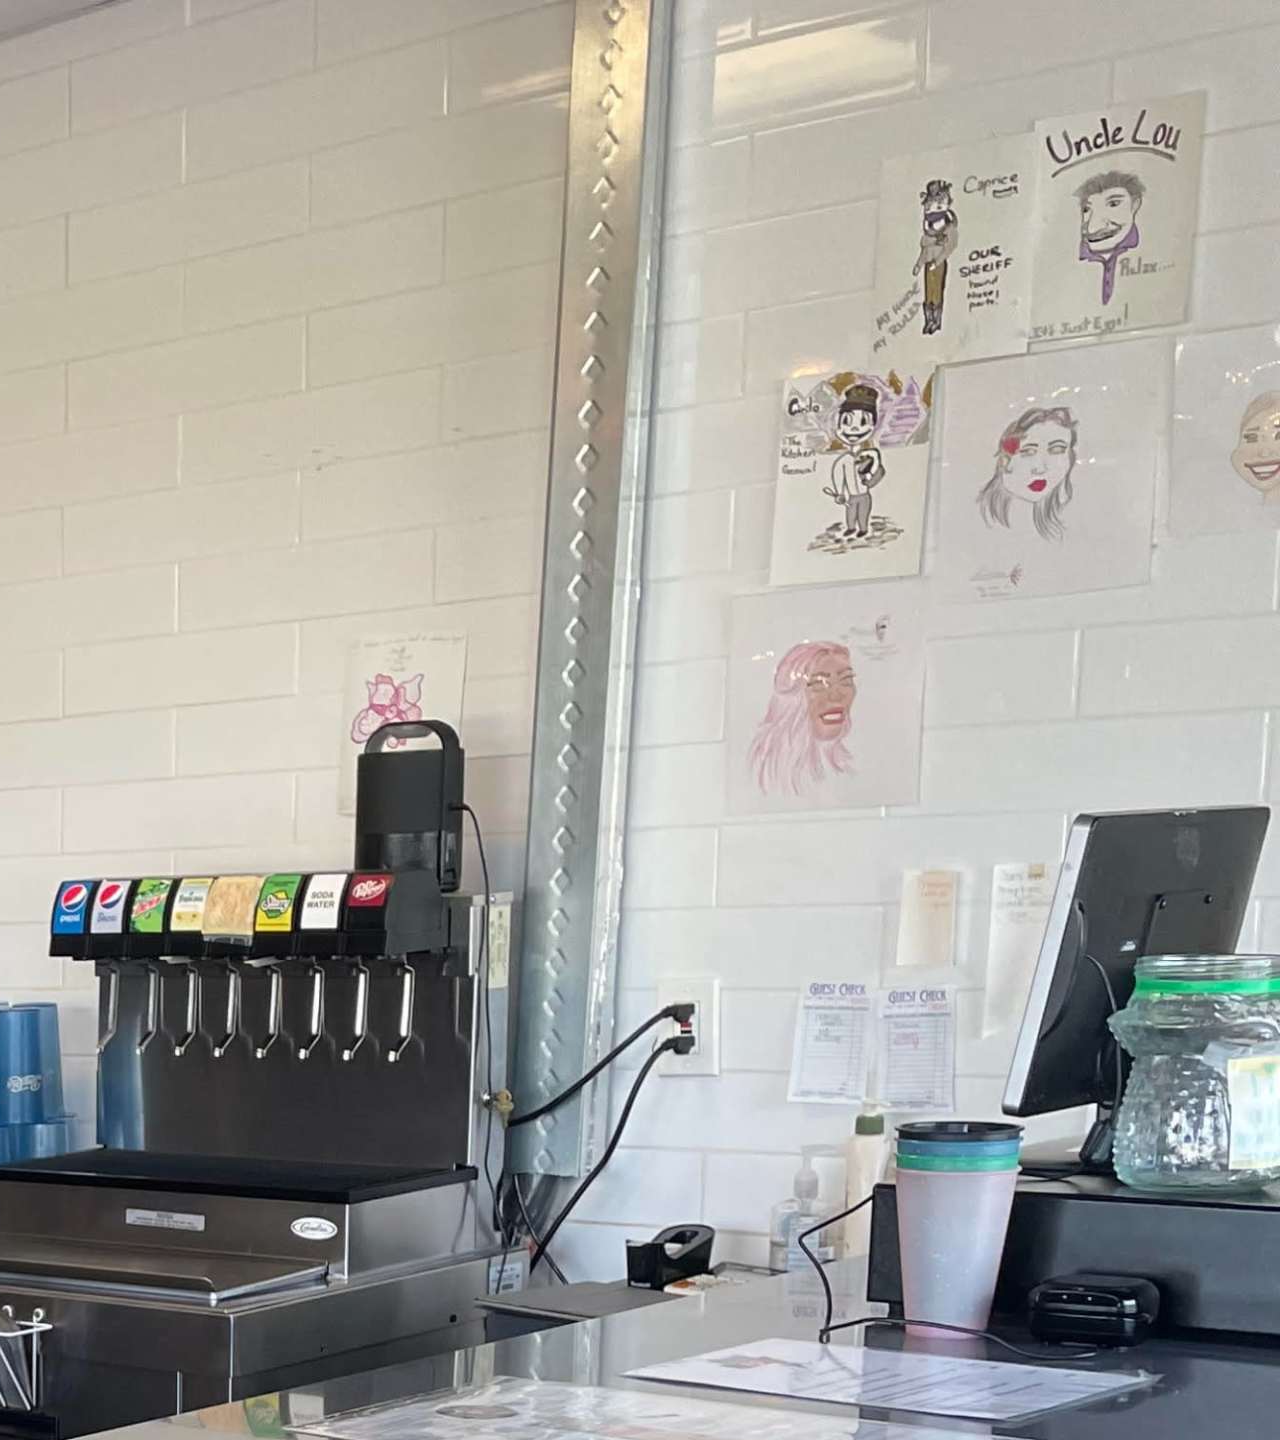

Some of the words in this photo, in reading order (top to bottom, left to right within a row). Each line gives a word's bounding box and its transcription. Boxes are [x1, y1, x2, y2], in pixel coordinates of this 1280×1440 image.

[1046, 117, 1124, 164] Uncle
[1131, 109, 1182, 151] Lou
[963, 173, 1019, 197] Caprice
[968, 245, 1002, 262] OUR
[958, 257, 1014, 278] SHERIFF
[876, 312, 891, 331] MY
[1060, 316, 1093, 335] Just
[872, 335, 888, 353] MY
[310, 891, 334, 899] SODA
[306, 901, 335, 909] WATER
[809, 982, 836, 996] GUEST
[838, 982, 866, 996] CHECK
[887, 990, 916, 1004] GUEST
[919, 989, 947, 1003] CHECK
